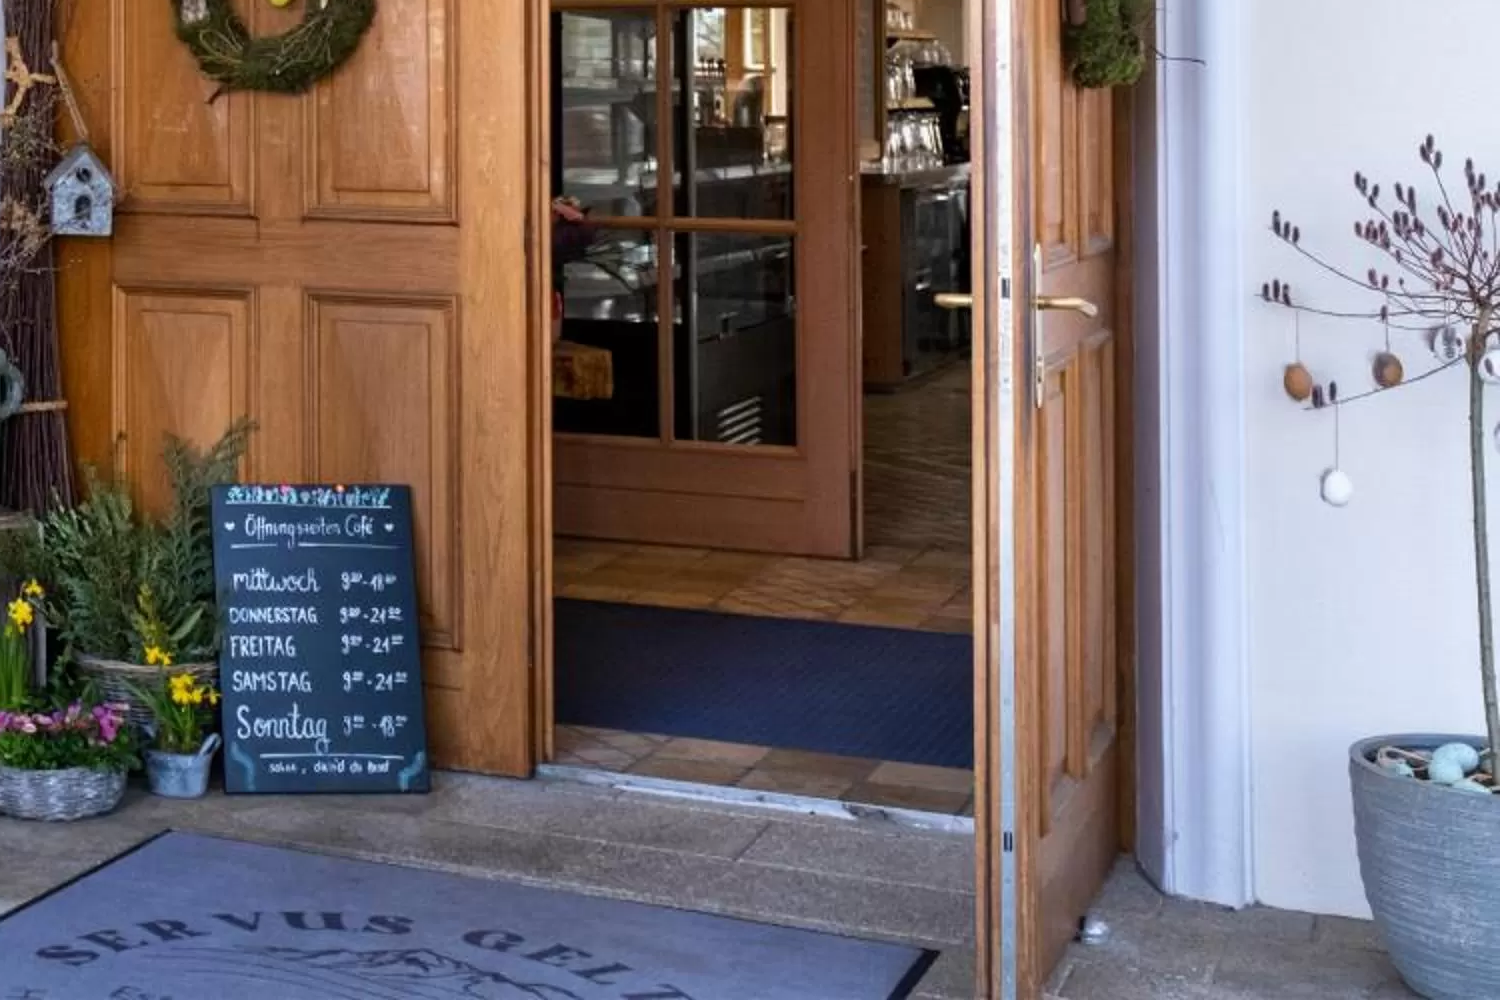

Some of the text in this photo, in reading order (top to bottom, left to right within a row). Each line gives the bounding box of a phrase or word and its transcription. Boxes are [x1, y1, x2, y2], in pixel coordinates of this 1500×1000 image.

[229, 606, 319, 625] DONNERSTAG
[230, 635, 297, 659] FREITAG
[232, 670, 313, 693] SAMSTAG
[236, 701, 332, 756] Sonntag
[35, 911, 415, 967] SERVUS
